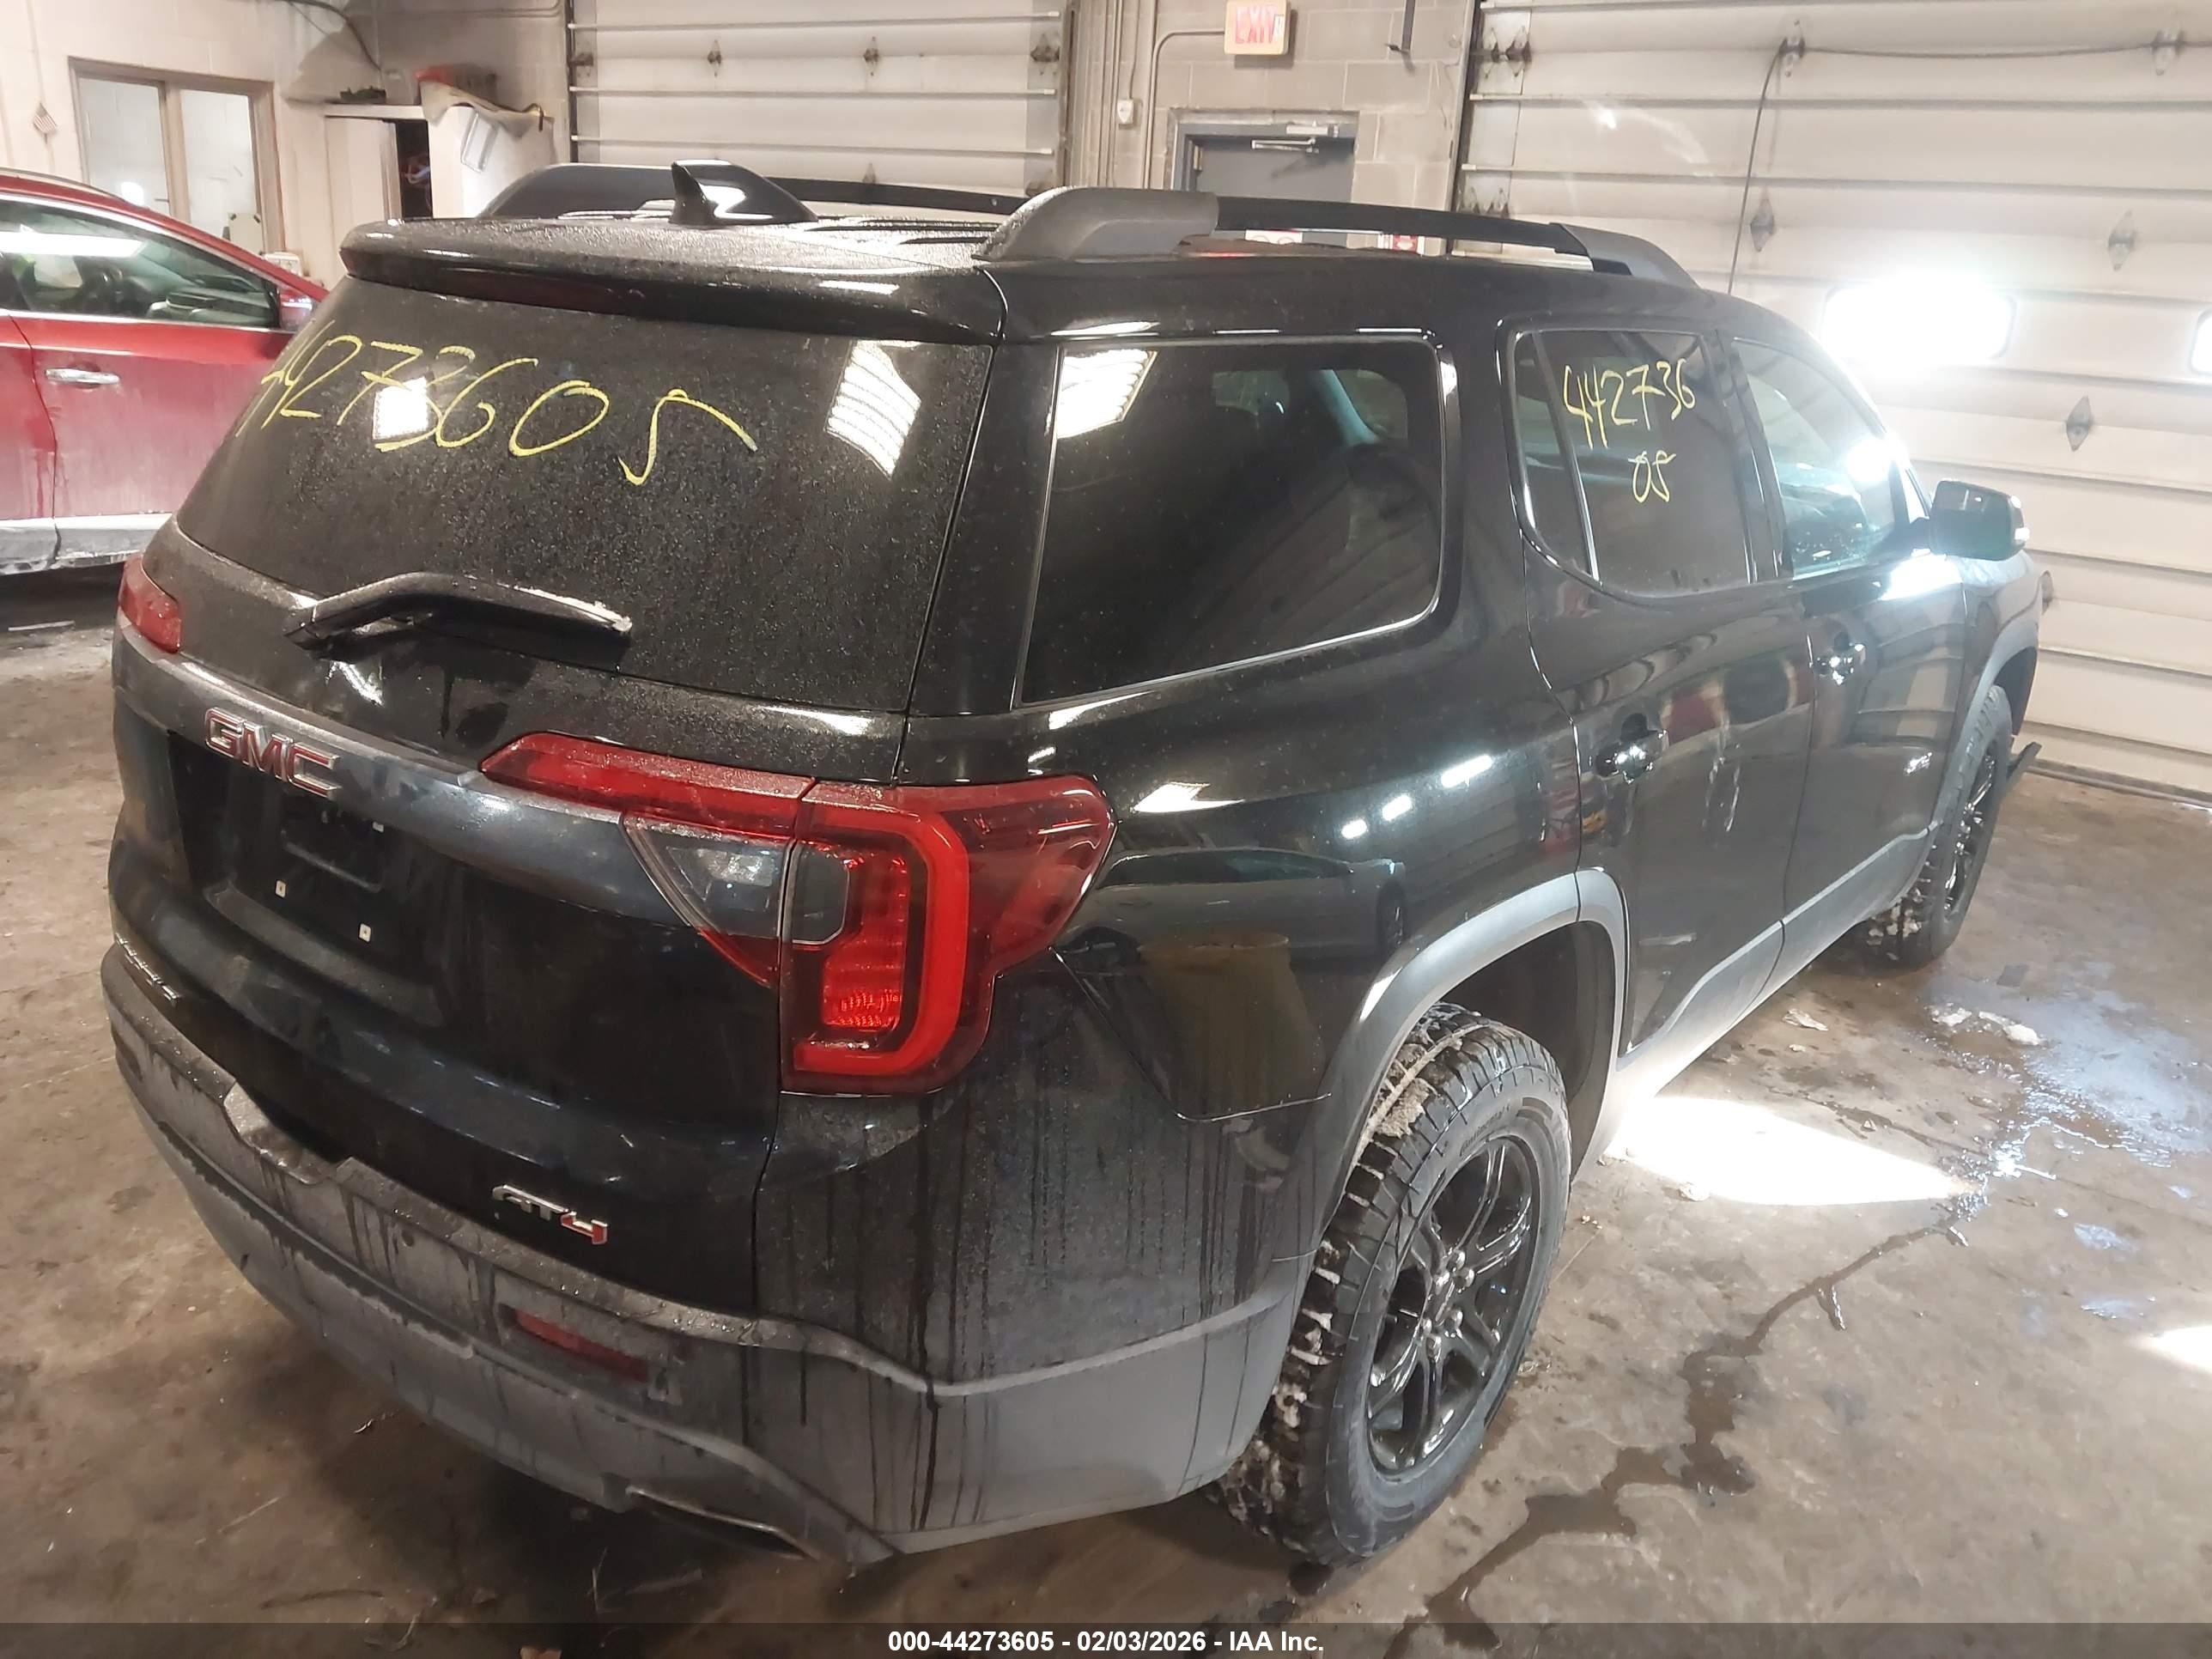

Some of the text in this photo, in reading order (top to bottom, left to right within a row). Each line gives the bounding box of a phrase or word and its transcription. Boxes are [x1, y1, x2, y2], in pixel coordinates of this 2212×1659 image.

[1563, 357, 1696, 452] 442736
[1627, 449, 1677, 504] 05
[204, 707, 342, 801] GMC
[492, 1184, 608, 1245] AT4
